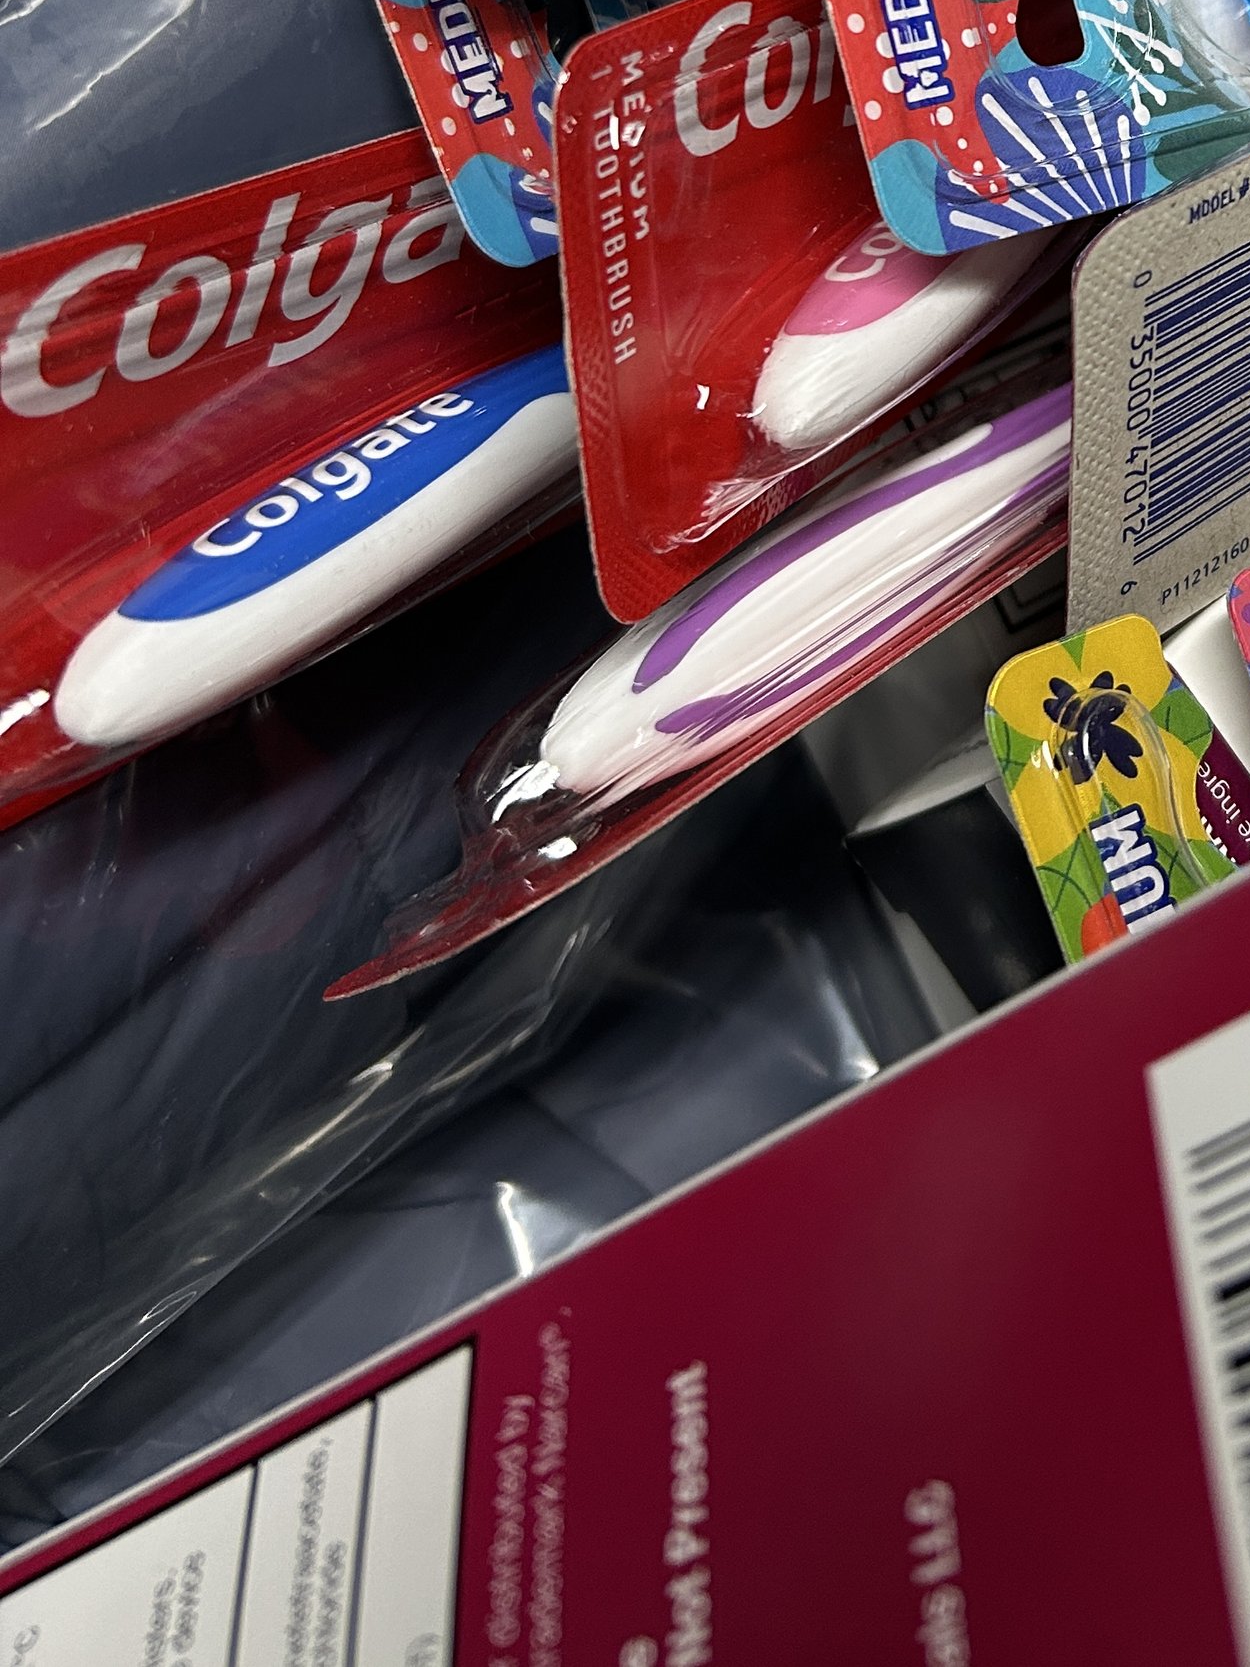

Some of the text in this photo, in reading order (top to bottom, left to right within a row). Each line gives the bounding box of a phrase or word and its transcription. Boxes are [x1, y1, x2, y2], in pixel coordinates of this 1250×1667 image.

[2, 181, 470, 418] Colga
[592, 99, 637, 365] TOOTHBRUSH
[192, 390, 475, 557] Colgate
[1160, 537, 1250, 604] P11212160
[1091, 810, 1175, 934] IUM
